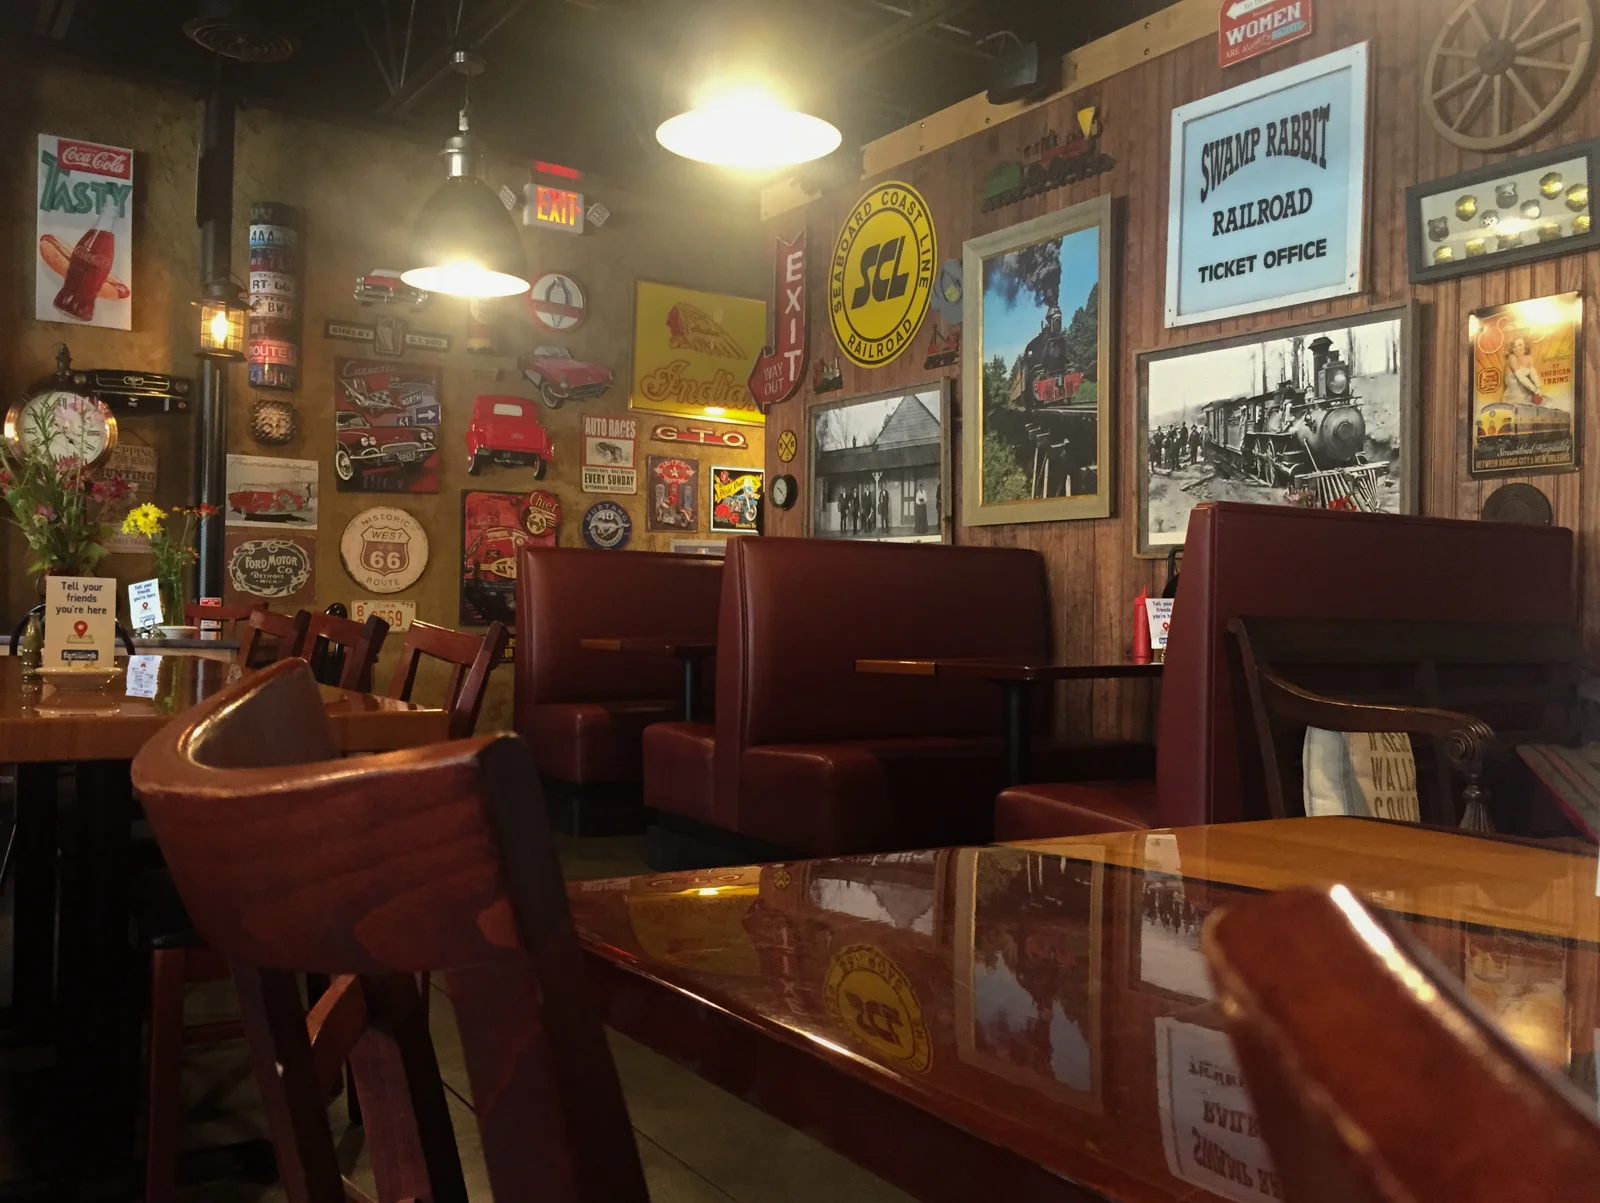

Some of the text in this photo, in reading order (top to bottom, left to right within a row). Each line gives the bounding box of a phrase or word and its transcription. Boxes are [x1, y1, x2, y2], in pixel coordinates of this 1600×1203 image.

[1226, 1, 1302, 46] WOMEN
[62, 146, 127, 173] Coca-Cola
[1201, 103, 1330, 203] SWAMP RABBIT
[40, 149, 133, 218] TASTY
[536, 187, 578, 226] EXIT
[1212, 187, 1313, 237] RAILROAD
[832, 191, 933, 314] SEABOARD COAST LINE
[1198, 238, 1327, 283] TICKET OFFICE
[851, 235, 910, 310] SCL
[784, 251, 803, 382] EXIT
[332, 327, 372, 338] SHELBY
[847, 318, 912, 358] RAILROAD
[763, 361, 784, 382] WAY
[1542, 376, 1569, 386] TRAINS
[764, 378, 785, 396] OUT
[585, 417, 636, 438] AUTO RACES
[1500, 456, 1519, 467] KANSAS
[584, 473, 634, 486] EVERY SUNDAY
[530, 492, 558, 513] Chief
[586, 503, 629, 522] MUSTANG
[361, 514, 411, 528] HISTORIC
[372, 530, 403, 539] WEST
[245, 554, 298, 570] FORD MOTOR
[370, 550, 401, 569] 66
[61, 581, 103, 594] Tell your
[366, 577, 400, 586] ROUTE
[66, 592, 97, 603] friends
[56, 605, 107, 615] you're here
